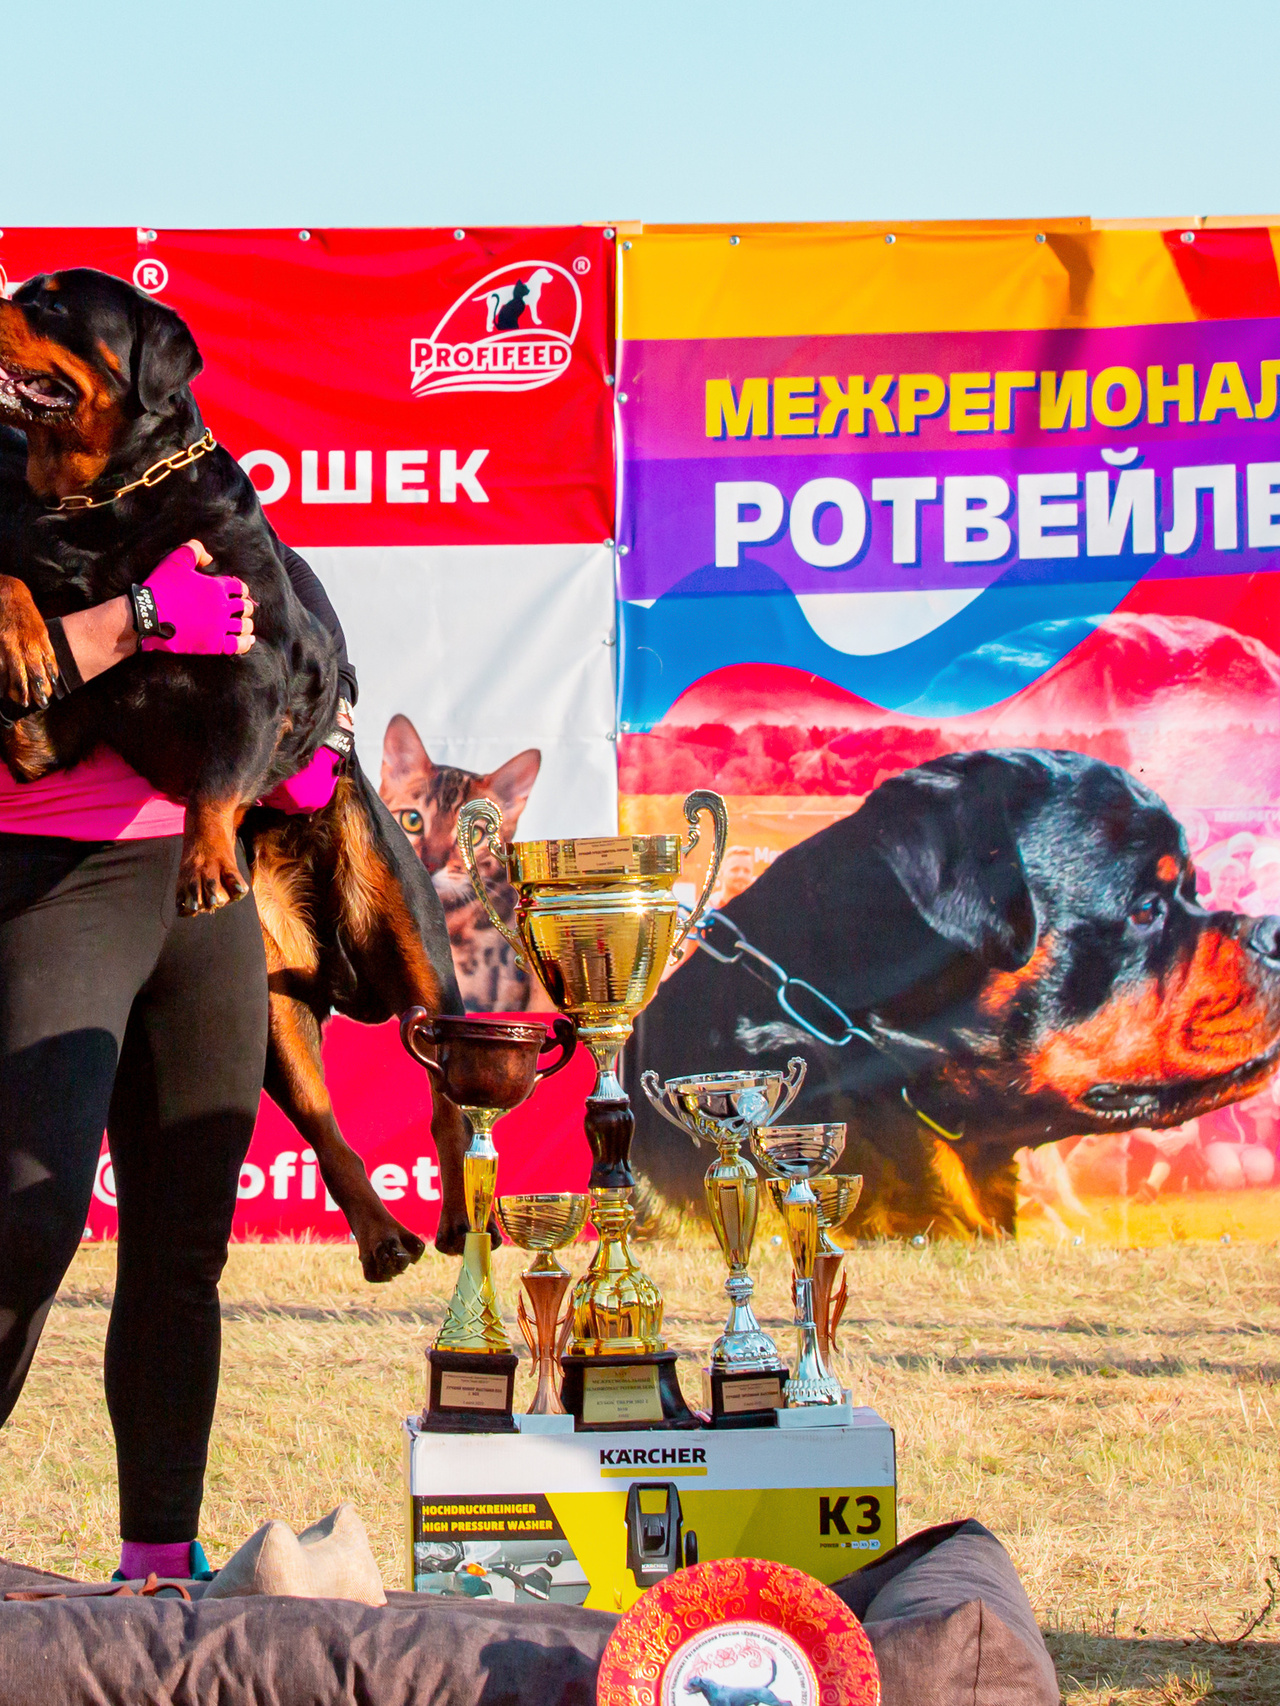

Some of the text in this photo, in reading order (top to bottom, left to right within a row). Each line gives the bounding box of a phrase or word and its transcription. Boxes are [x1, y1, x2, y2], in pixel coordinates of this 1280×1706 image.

[705, 359, 1280, 438] МЕЖРЕГИОНАЛ
[239, 449, 490, 504] ОШЕК
[714, 446, 1280, 569] РОТВЕЙЛЕ
[600, 1448, 707, 1464] KÄRCHER
[422, 1504, 536, 1515] HOCHDRUCKREINIGER
[422, 1520, 553, 1532] HIGH PRESSURE WASHER
[819, 1495, 881, 1535] K3
